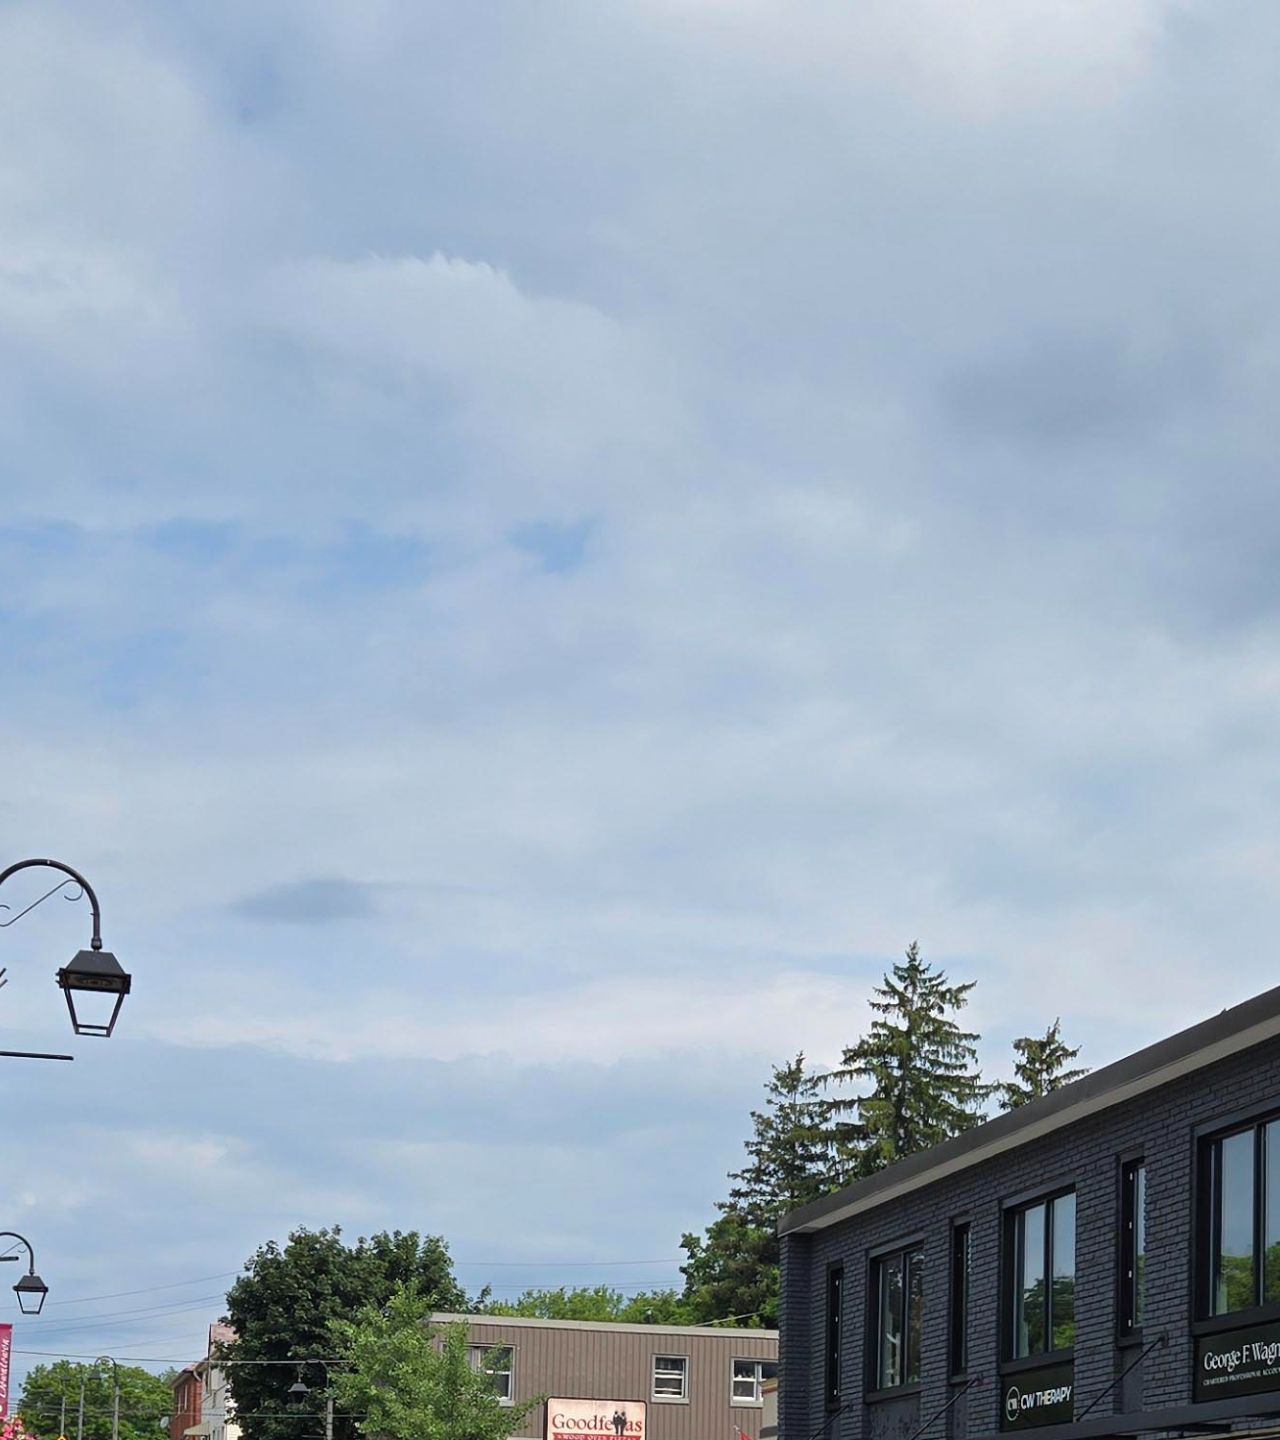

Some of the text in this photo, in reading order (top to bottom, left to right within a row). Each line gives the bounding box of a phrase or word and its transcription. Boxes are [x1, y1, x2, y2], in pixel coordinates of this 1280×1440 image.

[1204, 1350, 1241, 1372] George
[1242, 1345, 1251, 1363] F.
[1021, 1386, 1072, 1410] CW THERAPY
[552, 1412, 643, 1433] Goodfeas
